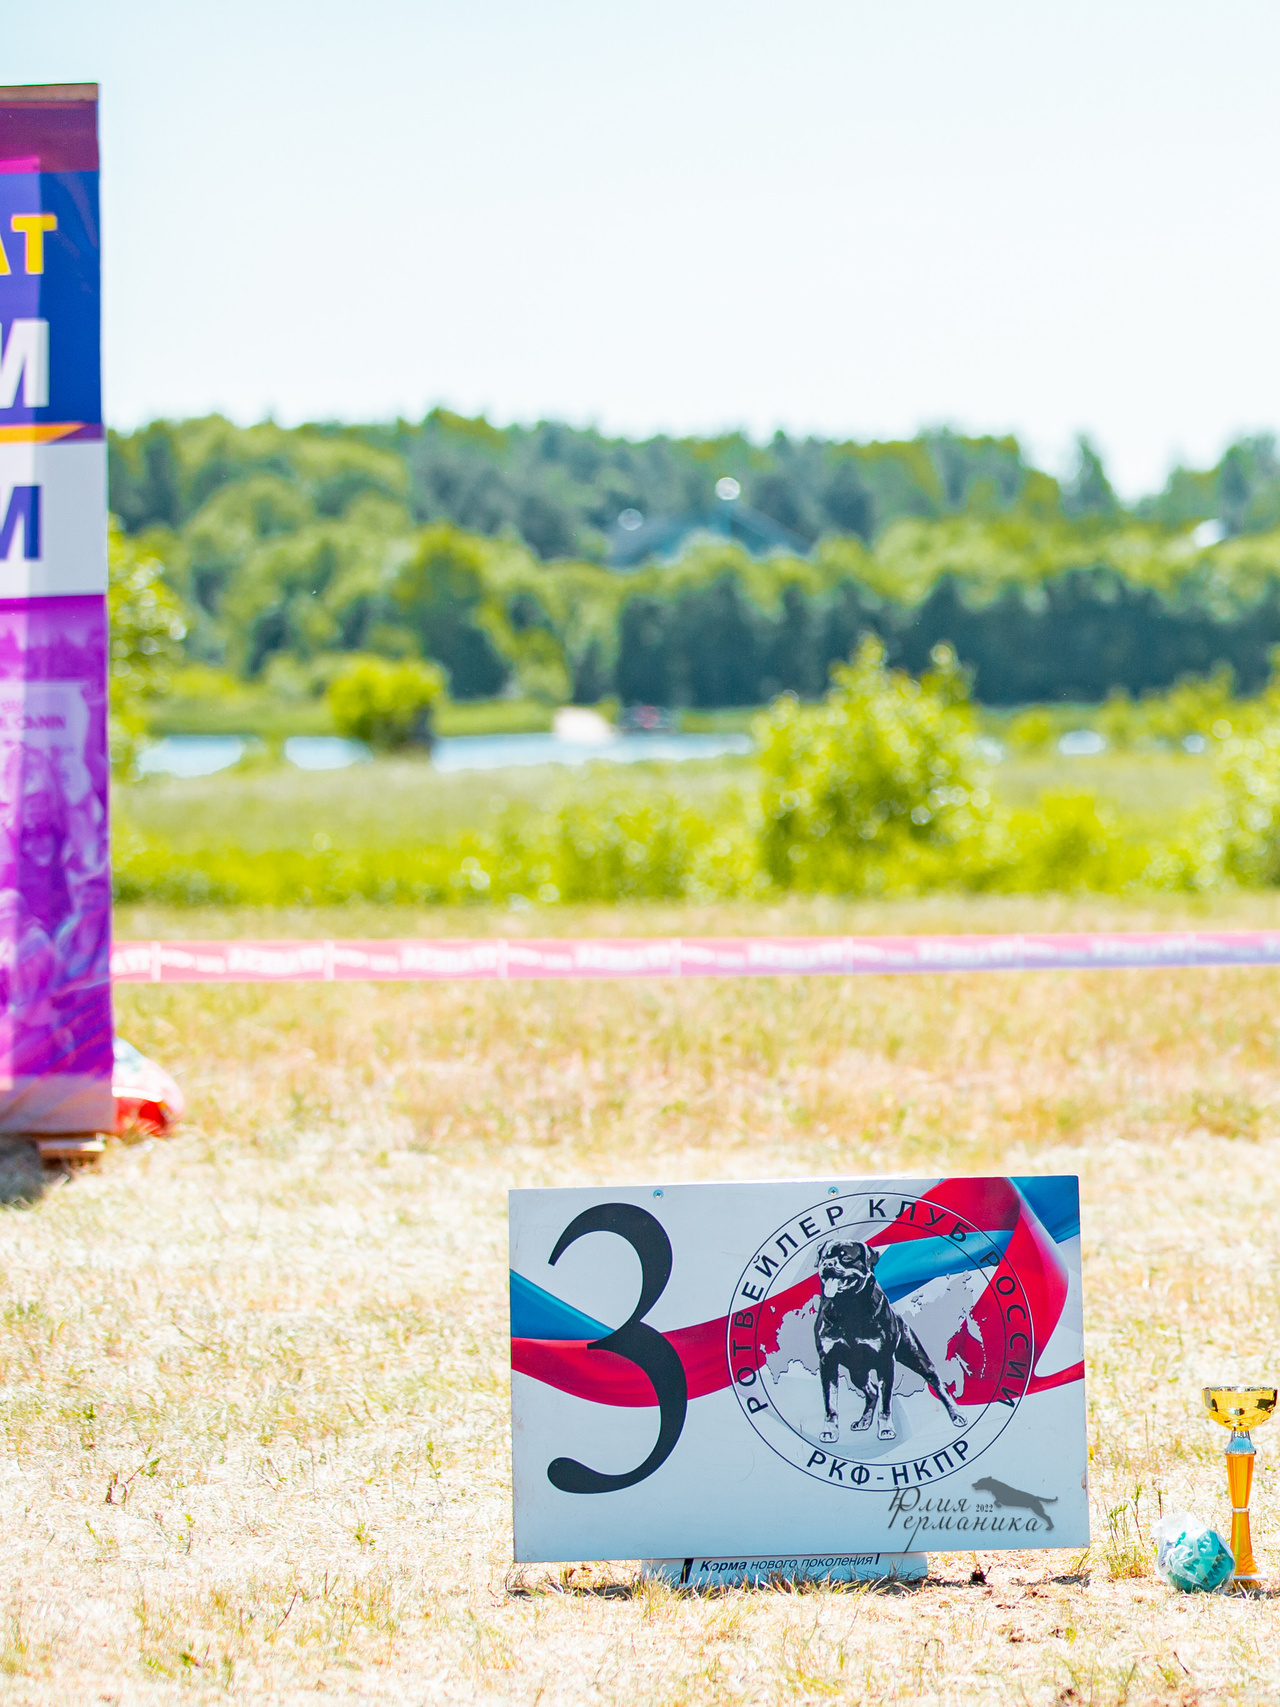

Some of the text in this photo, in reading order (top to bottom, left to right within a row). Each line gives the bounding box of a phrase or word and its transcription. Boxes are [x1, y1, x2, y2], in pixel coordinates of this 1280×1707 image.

[548, 1203, 688, 1494] 3
[733, 1198, 1029, 1415] РОТВЕЙЛЕР КЛУБ РОССИИ
[806, 1439, 969, 1486] РКФ-НКПР
[700, 1555, 874, 1574] Корма нового поколения
